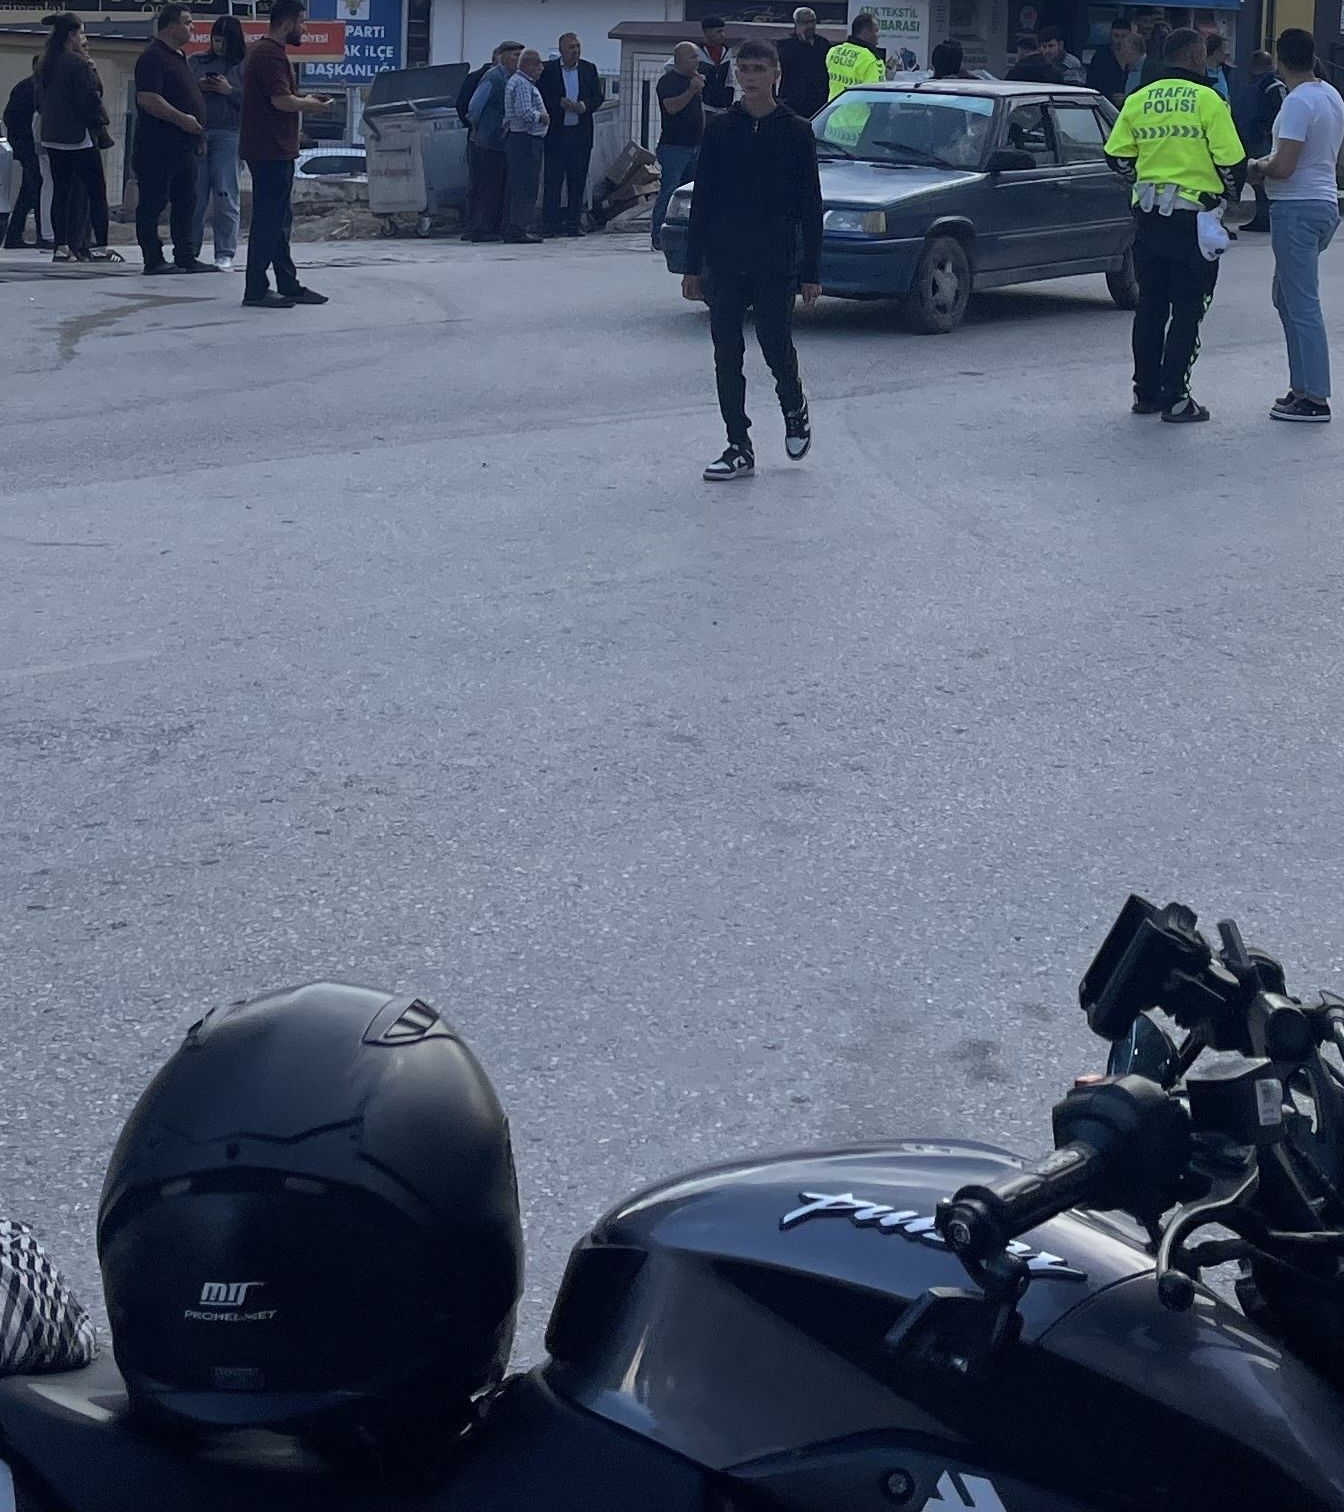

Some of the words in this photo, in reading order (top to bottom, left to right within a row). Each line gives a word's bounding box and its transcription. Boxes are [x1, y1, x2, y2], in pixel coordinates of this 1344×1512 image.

[881, 6, 919, 19] TEKSTİL
[345, 24, 385, 38] PARTİ
[365, 45, 394, 61] İLÇE
[1143, 99, 1197, 114] POLİSİ
